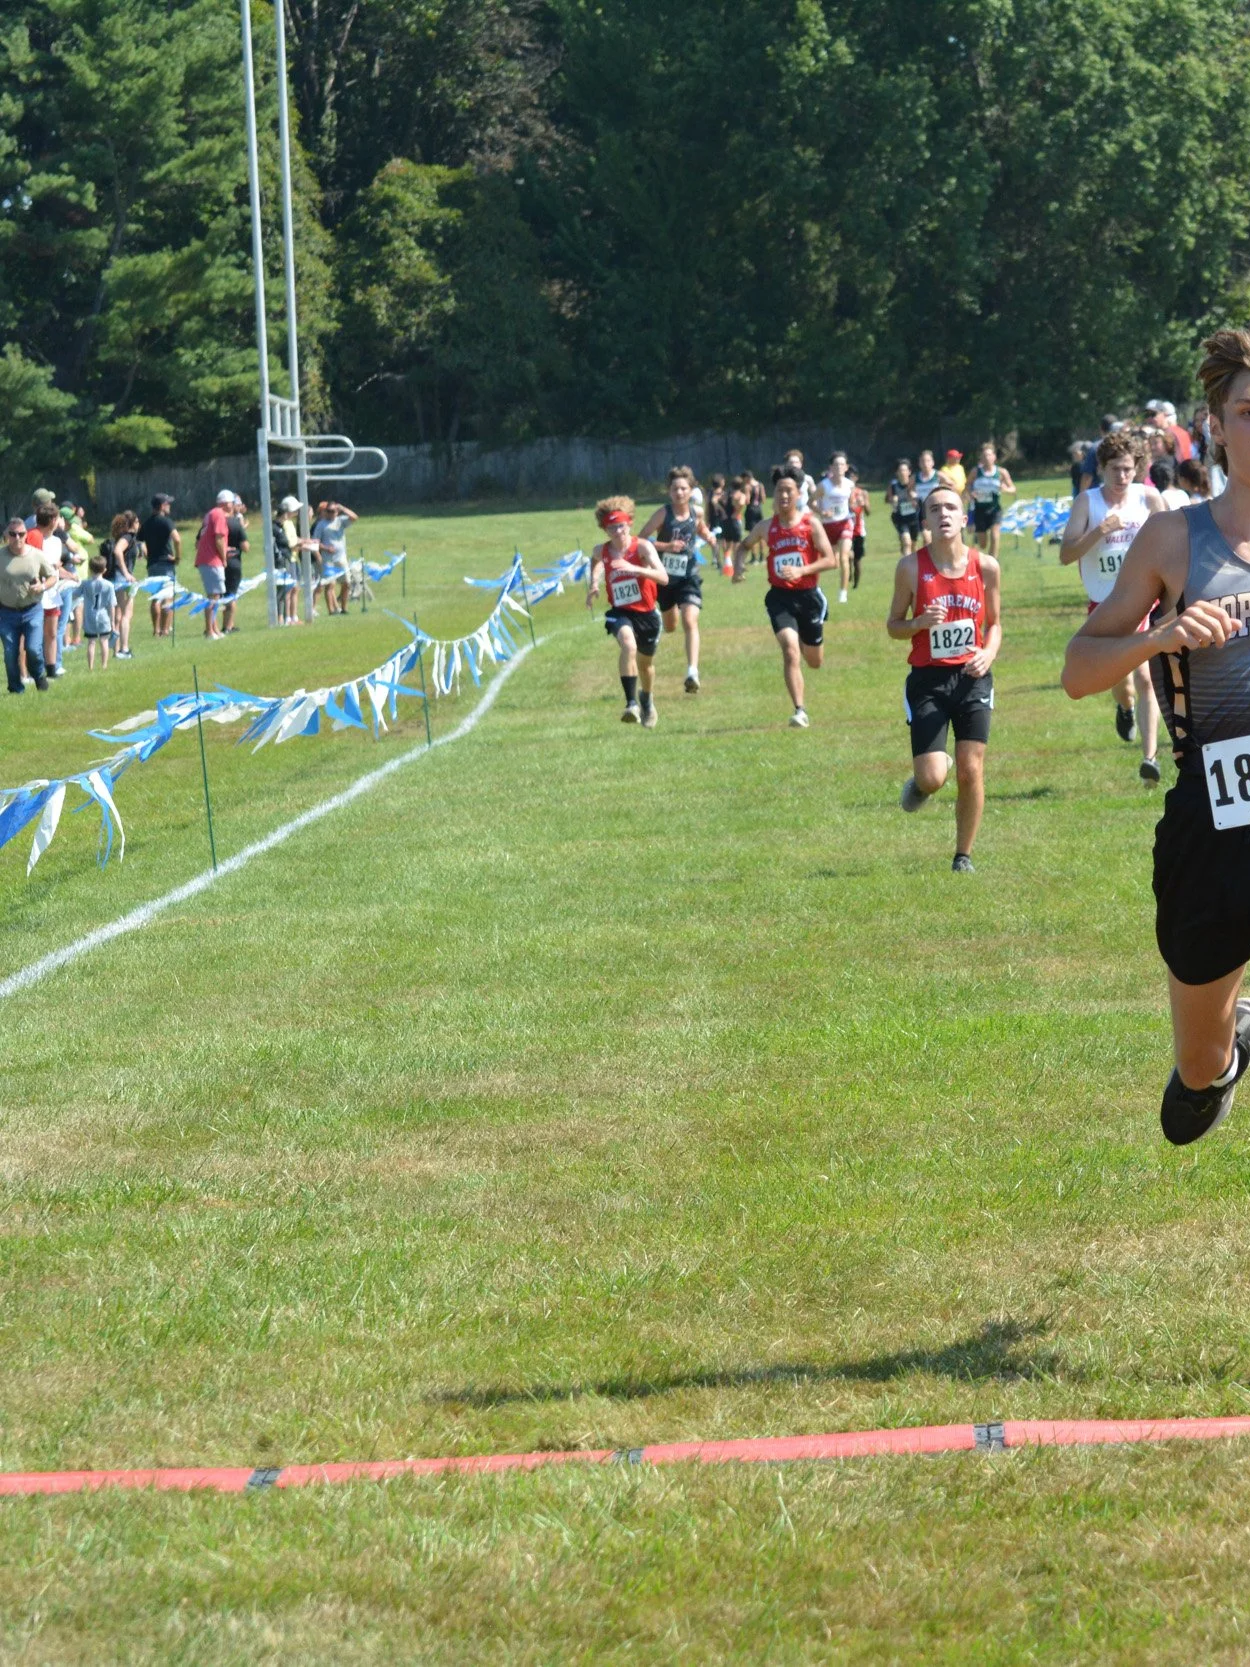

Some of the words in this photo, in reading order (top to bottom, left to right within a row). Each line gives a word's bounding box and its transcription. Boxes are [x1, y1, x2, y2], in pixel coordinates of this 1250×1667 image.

[1099, 554, 1123, 573] 191
[613, 583, 640, 600] 1820
[931, 626, 973, 650] 1822
